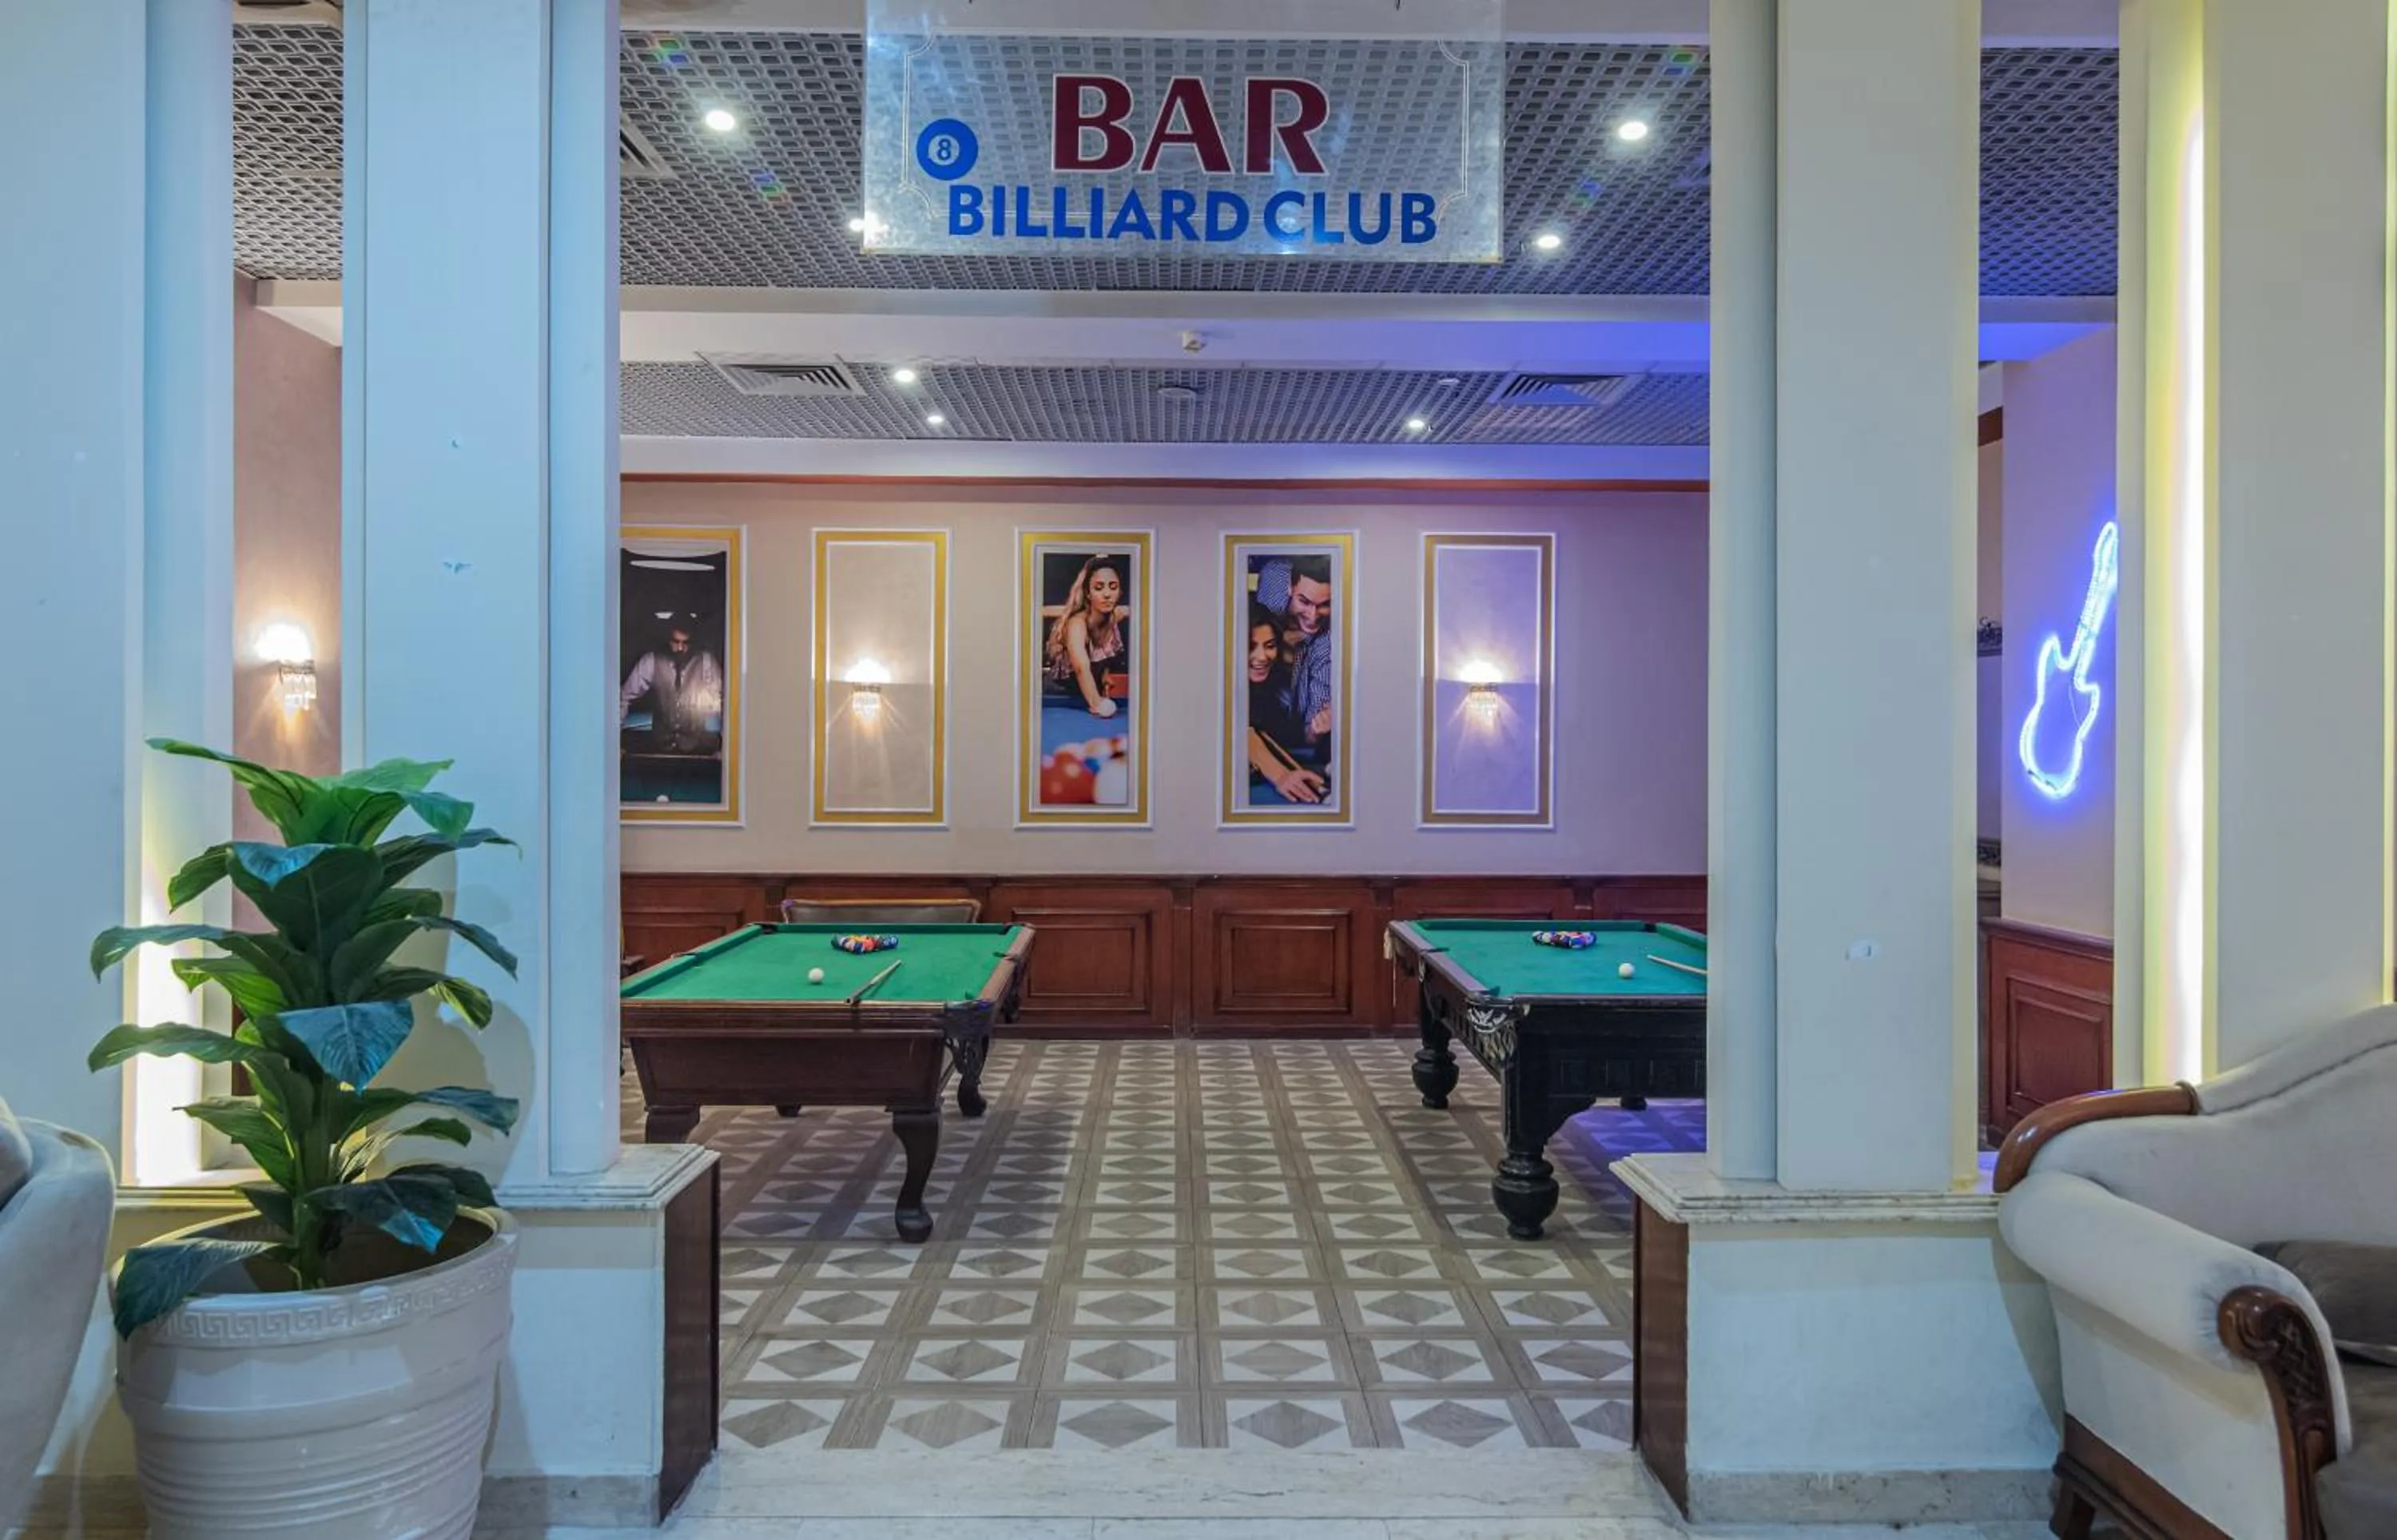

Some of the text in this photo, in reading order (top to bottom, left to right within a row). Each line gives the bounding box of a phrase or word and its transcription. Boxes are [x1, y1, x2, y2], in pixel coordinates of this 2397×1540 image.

[937, 138, 951, 160] 8
[1051, 73, 1330, 176] BAR
[948, 185, 1437, 244] BILLIARD CLUB
